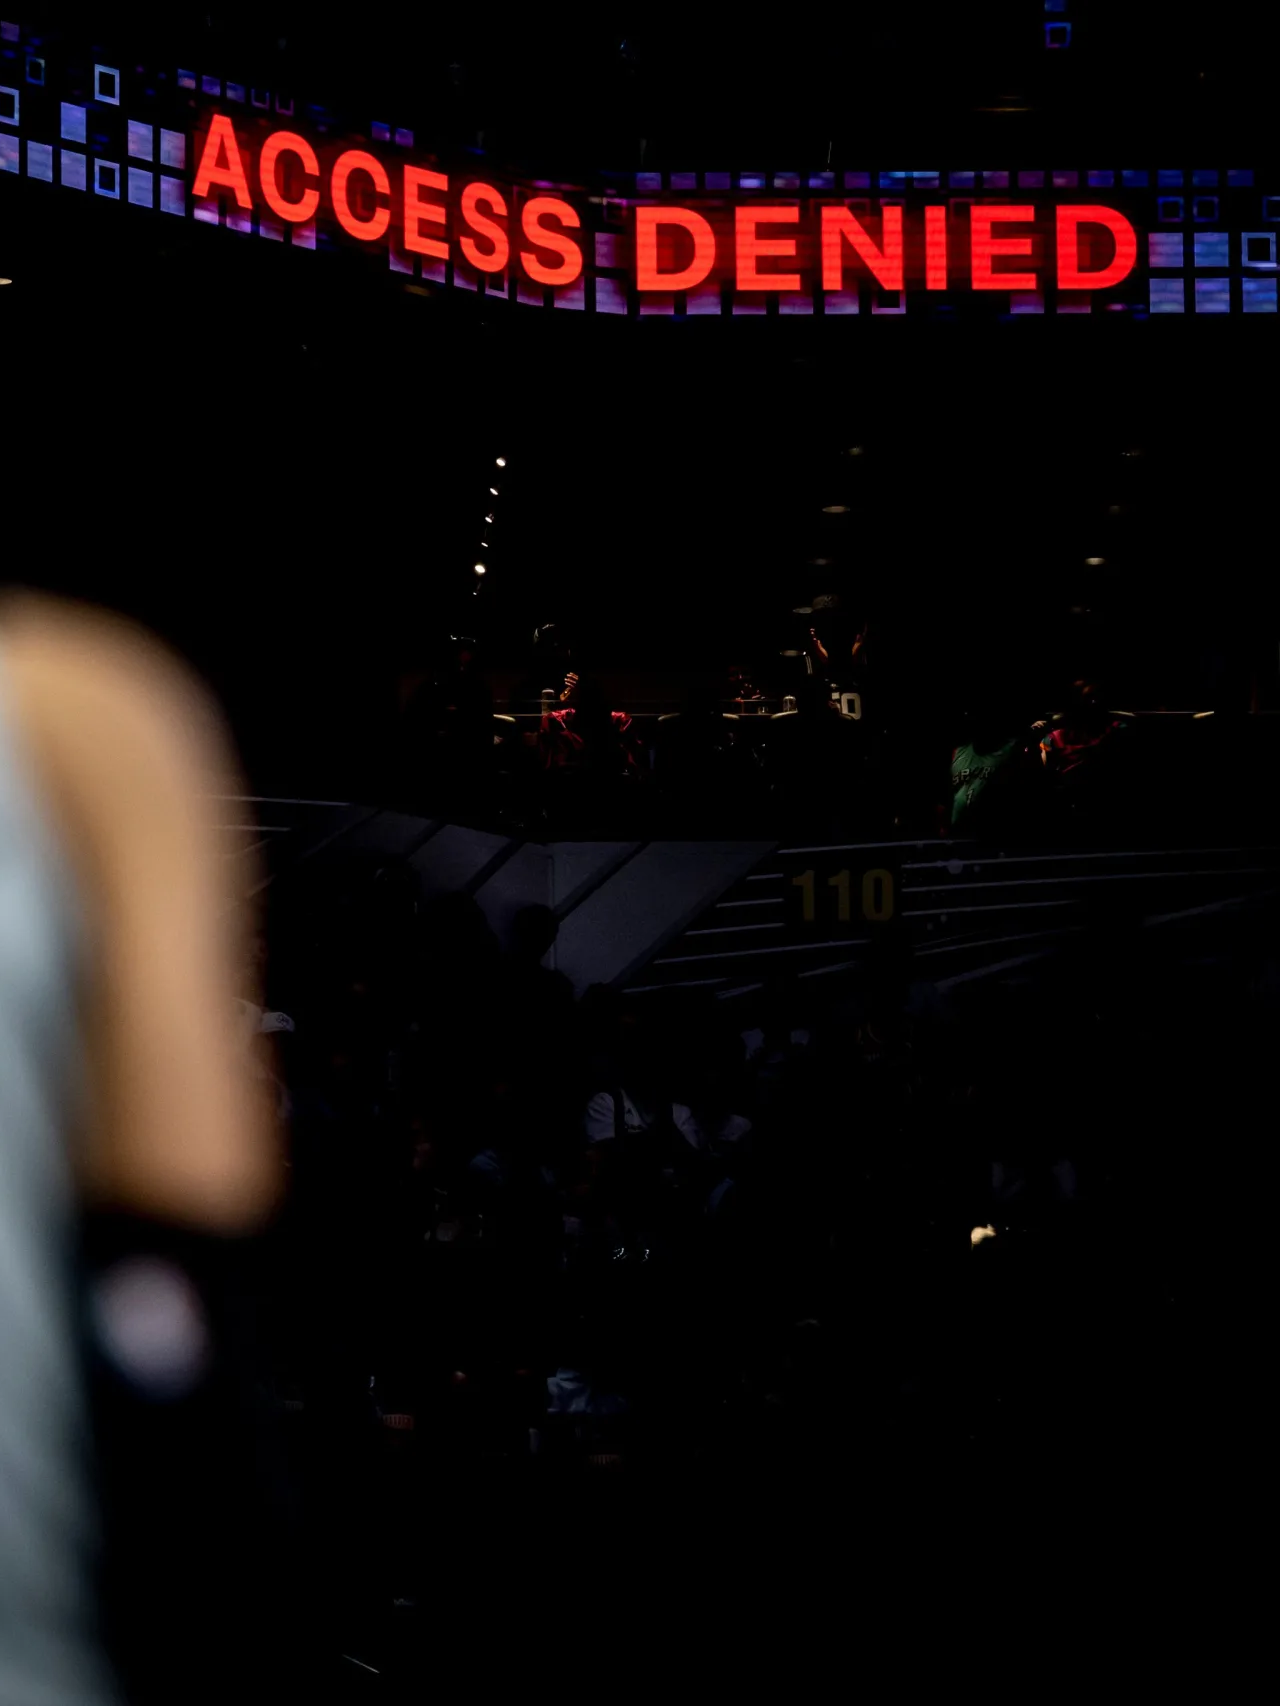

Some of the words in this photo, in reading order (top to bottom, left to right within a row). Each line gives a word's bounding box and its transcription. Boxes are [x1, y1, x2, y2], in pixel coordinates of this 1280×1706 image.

[193, 115, 584, 286] ACCESS
[637, 206, 1137, 291] DENIED
[792, 868, 895, 923] 110
